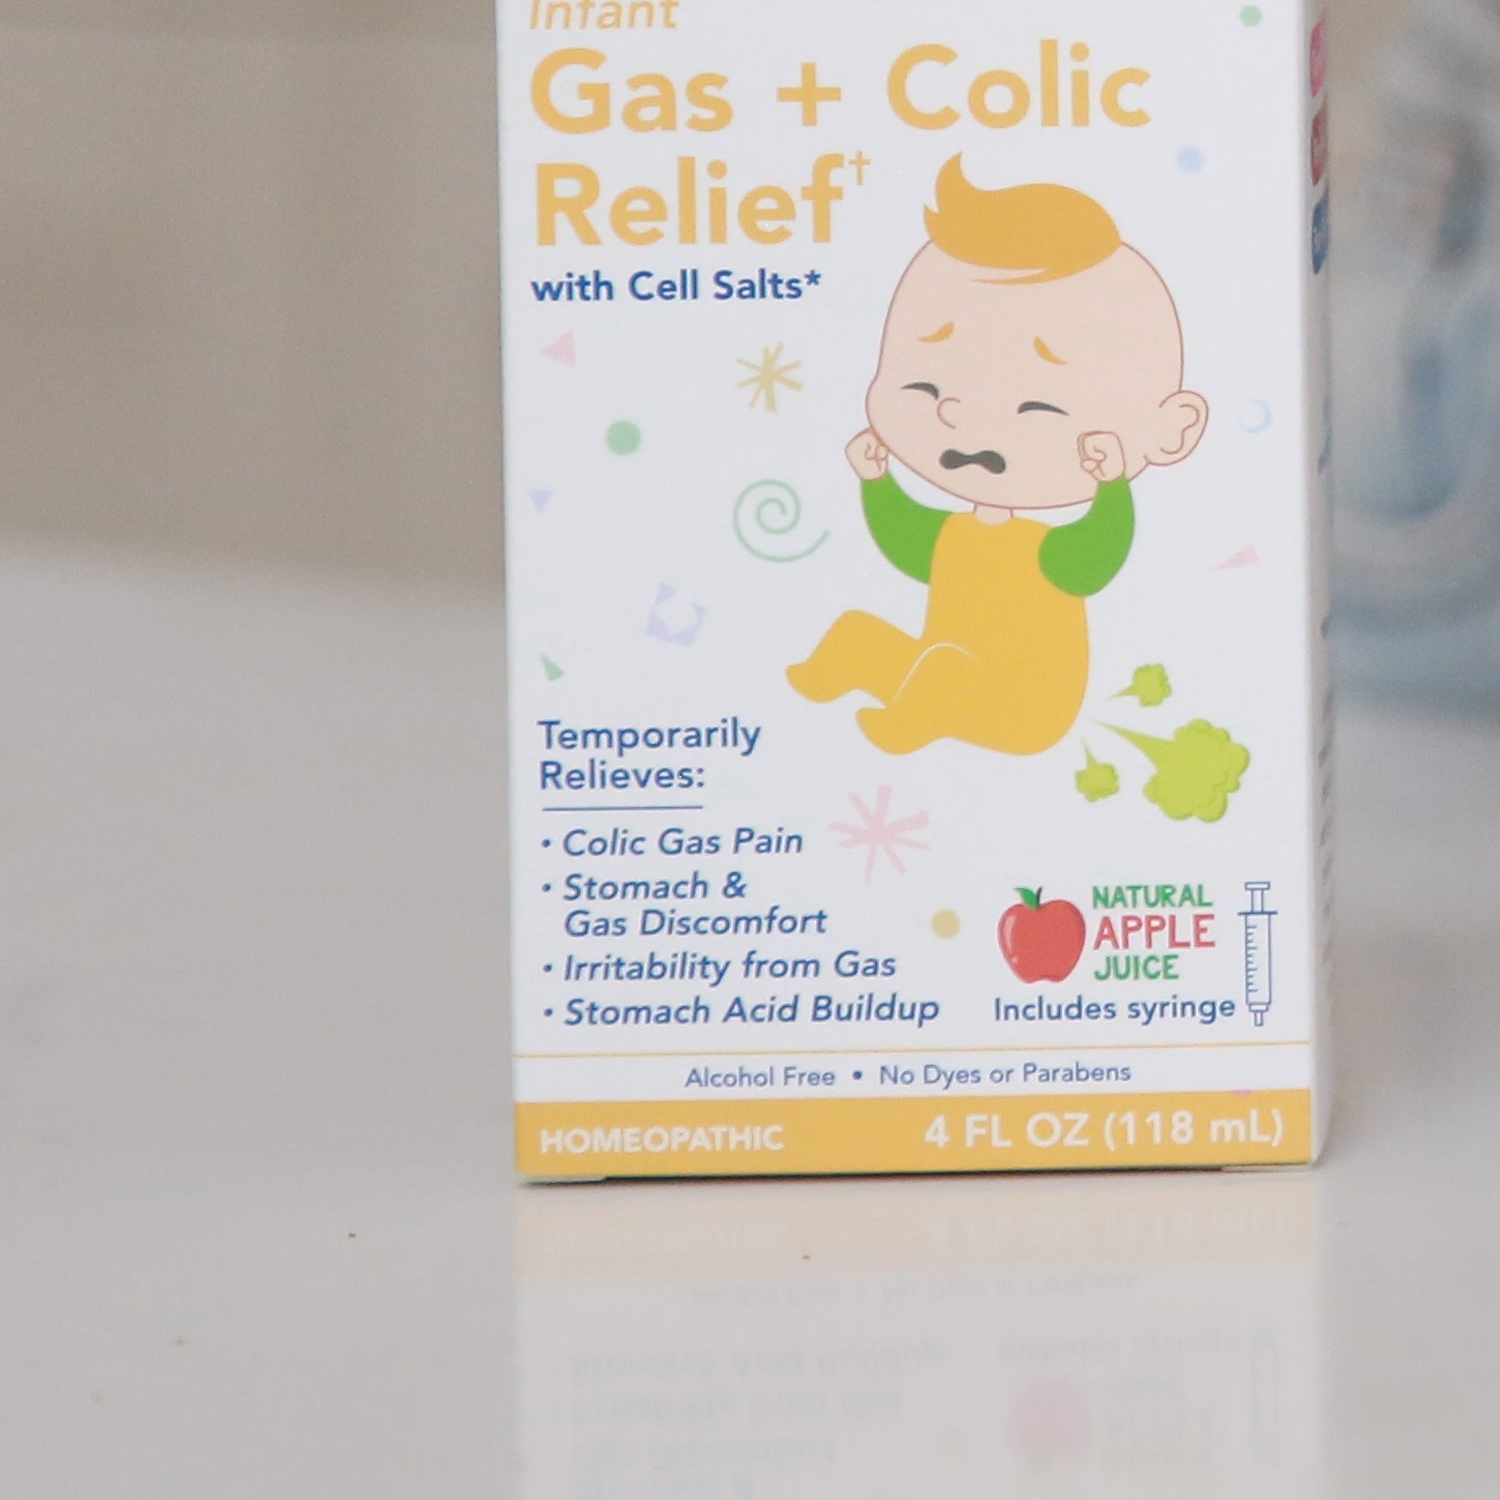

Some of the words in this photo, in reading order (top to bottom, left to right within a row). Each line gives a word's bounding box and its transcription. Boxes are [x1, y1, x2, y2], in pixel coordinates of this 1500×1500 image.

[529, 46, 734, 135] Gas
[776, 61, 843, 128] +
[886, 38, 1152, 131] Colic
[530, 269, 614, 302] with
[628, 268, 699, 301] Cell
[536, 716, 762, 757] Temporarily
[540, 758, 705, 791] Relieves:
[562, 827, 647, 857] Colic
[657, 827, 721, 856] Gas
[732, 826, 803, 855] Pain
[563, 870, 709, 902] Stomach
[721, 871, 747, 899] &
[1092, 883, 1214, 910] NATURAL
[564, 909, 627, 938] Gas
[639, 904, 828, 936] Discomfort
[1093, 913, 1216, 951] APPLE
[564, 950, 732, 987] Irritability
[741, 949, 821, 979] from
[834, 949, 896, 978] Gas
[1093, 953, 1180, 981] JUICE
[564, 995, 710, 1026] Stomach
[721, 993, 800, 1023] Acid
[811, 992, 940, 1029] Buildup
[994, 994, 1117, 1021] Includes
[1127, 994, 1236, 1027] syringe
[684, 1065, 775, 1088] Alcohol
[783, 1065, 836, 1087] Free
[879, 1064, 915, 1086] No
[923, 1063, 982, 1091] Dyes
[989, 1068, 1015, 1084] or
[1022, 1060, 1132, 1083] Parabens
[539, 1123, 785, 1155] HOMEOPATHIC
[923, 1114, 951, 1149] 4
[964, 1113, 1014, 1149] FL
[1027, 1111, 1091, 1148] OZ
[1103, 1109, 1196, 1152] (118
[1209, 1107, 1285, 1148] mL)
